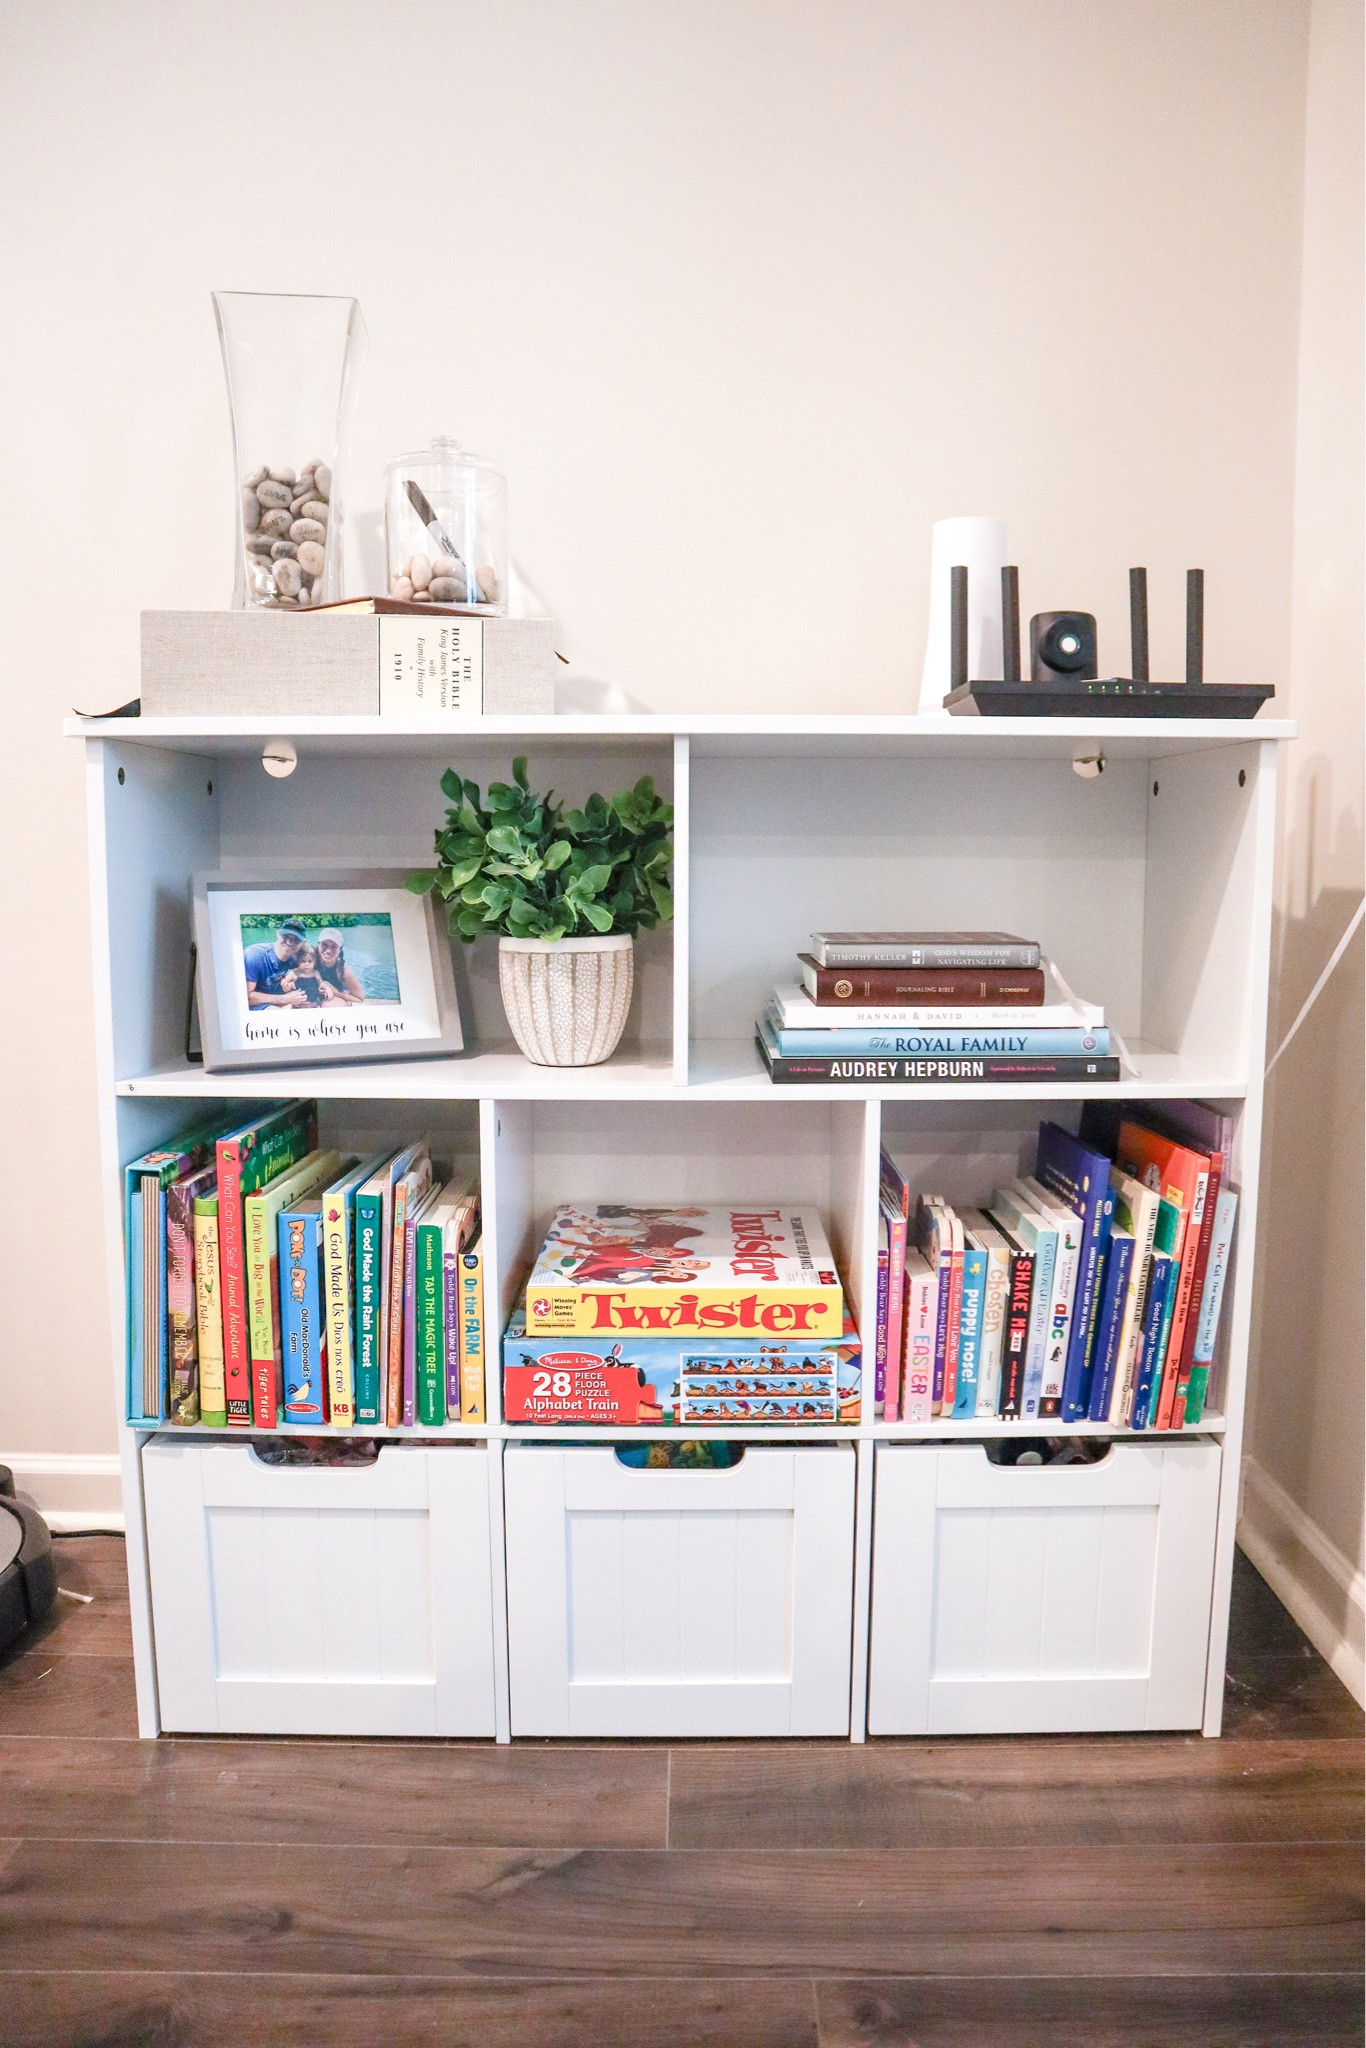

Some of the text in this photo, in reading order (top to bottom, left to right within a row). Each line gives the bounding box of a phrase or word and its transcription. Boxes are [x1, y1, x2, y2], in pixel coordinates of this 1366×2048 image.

[440, 629, 448, 649] King
[416, 638, 425, 699] Family History
[429, 660, 437, 677] with
[452, 628, 460, 710] HOLY BIBLE
[831, 953, 907, 961] TIMOTHY KELLER
[937, 958, 1008, 966] NAVIGATING LIFE
[959, 949, 1011, 957] WISDOM FOR
[913, 1012, 921, 1020] &
[245, 1018, 406, 1040] home is where you are
[869, 1037, 1028, 1052] The ROYAL FAMILY
[830, 1061, 984, 1077] AUDREY HEPBURN
[406, 1228, 414, 1243] LEVI
[729, 1210, 789, 1282] Twister
[203, 1235, 217, 1274] Jesus
[795, 1237, 807, 1245] TIES
[801, 1259, 814, 1270] KNOTS
[1187, 1246, 1196, 1268] Green
[1216, 1243, 1226, 1259] Pete
[224, 1174, 240, 1359] What Can You See? Animal Adventure
[252, 1214, 264, 1323] Love You Big World
[1133, 1207, 1157, 1323] THE VERY HUNGRY CATERPILLAR
[1213, 1264, 1222, 1277] Cat
[172, 1223, 187, 1358] DON'T FORGET TO REMEMBER
[196, 1241, 209, 1334] Storybook Bible
[290, 1267, 306, 1303] DOT!
[464, 1278, 478, 1293] On
[878, 1271, 886, 1290] Teddy
[941, 1271, 949, 1290] Teddy
[1012, 1261, 1032, 1312] SHAKE
[1183, 1271, 1192, 1289] Eggs
[362, 1228, 374, 1368] God Made the Rain Forest
[424, 1234, 436, 1374] Matheson TAP THE MAGIC TREE
[1083, 1292, 1091, 1306] WANT
[1109, 1245, 1129, 1342] Tillman love
[330, 1233, 346, 1394] God Made Us Dios nos creó
[393, 1302, 399, 1310] of
[465, 1296, 477, 1315] the
[581, 1293, 828, 1332] Twister
[1083, 1255, 1105, 1368] REALLY USEFUL STORIES FOR GROWING UP
[1178, 1308, 1186, 1324] Ham
[949, 1293, 961, 1363] Bear Love You
[1052, 1303, 1069, 1340] abc
[1160, 1318, 1170, 1347] MARSHALL
[290, 1332, 298, 1353] Farm
[301, 1308, 310, 1379] Old MacDonald's
[448, 1328, 457, 1350] Wake
[878, 1324, 886, 1342] Good
[961, 1288, 979, 1383] puppy nose!
[1144, 1301, 1162, 1372] Good Night Boston
[448, 1352, 457, 1365] Up!
[544, 1356, 599, 1367] Melissa Doug
[876, 1344, 887, 1364] Night
[936, 1343, 944, 1358] Hug
[911, 1335, 931, 1394] EASTER
[532, 1371, 572, 1397] 28
[575, 1372, 603, 1380] PIECE
[575, 1380, 607, 1388] FLOOR
[258, 1368, 270, 1419] tiger tales
[575, 1389, 610, 1397] PUZZLE
[1120, 1391, 1128, 1414] WORLD
[333, 1403, 349, 1413] KB
[523, 1397, 619, 1412] Alphabet Train
